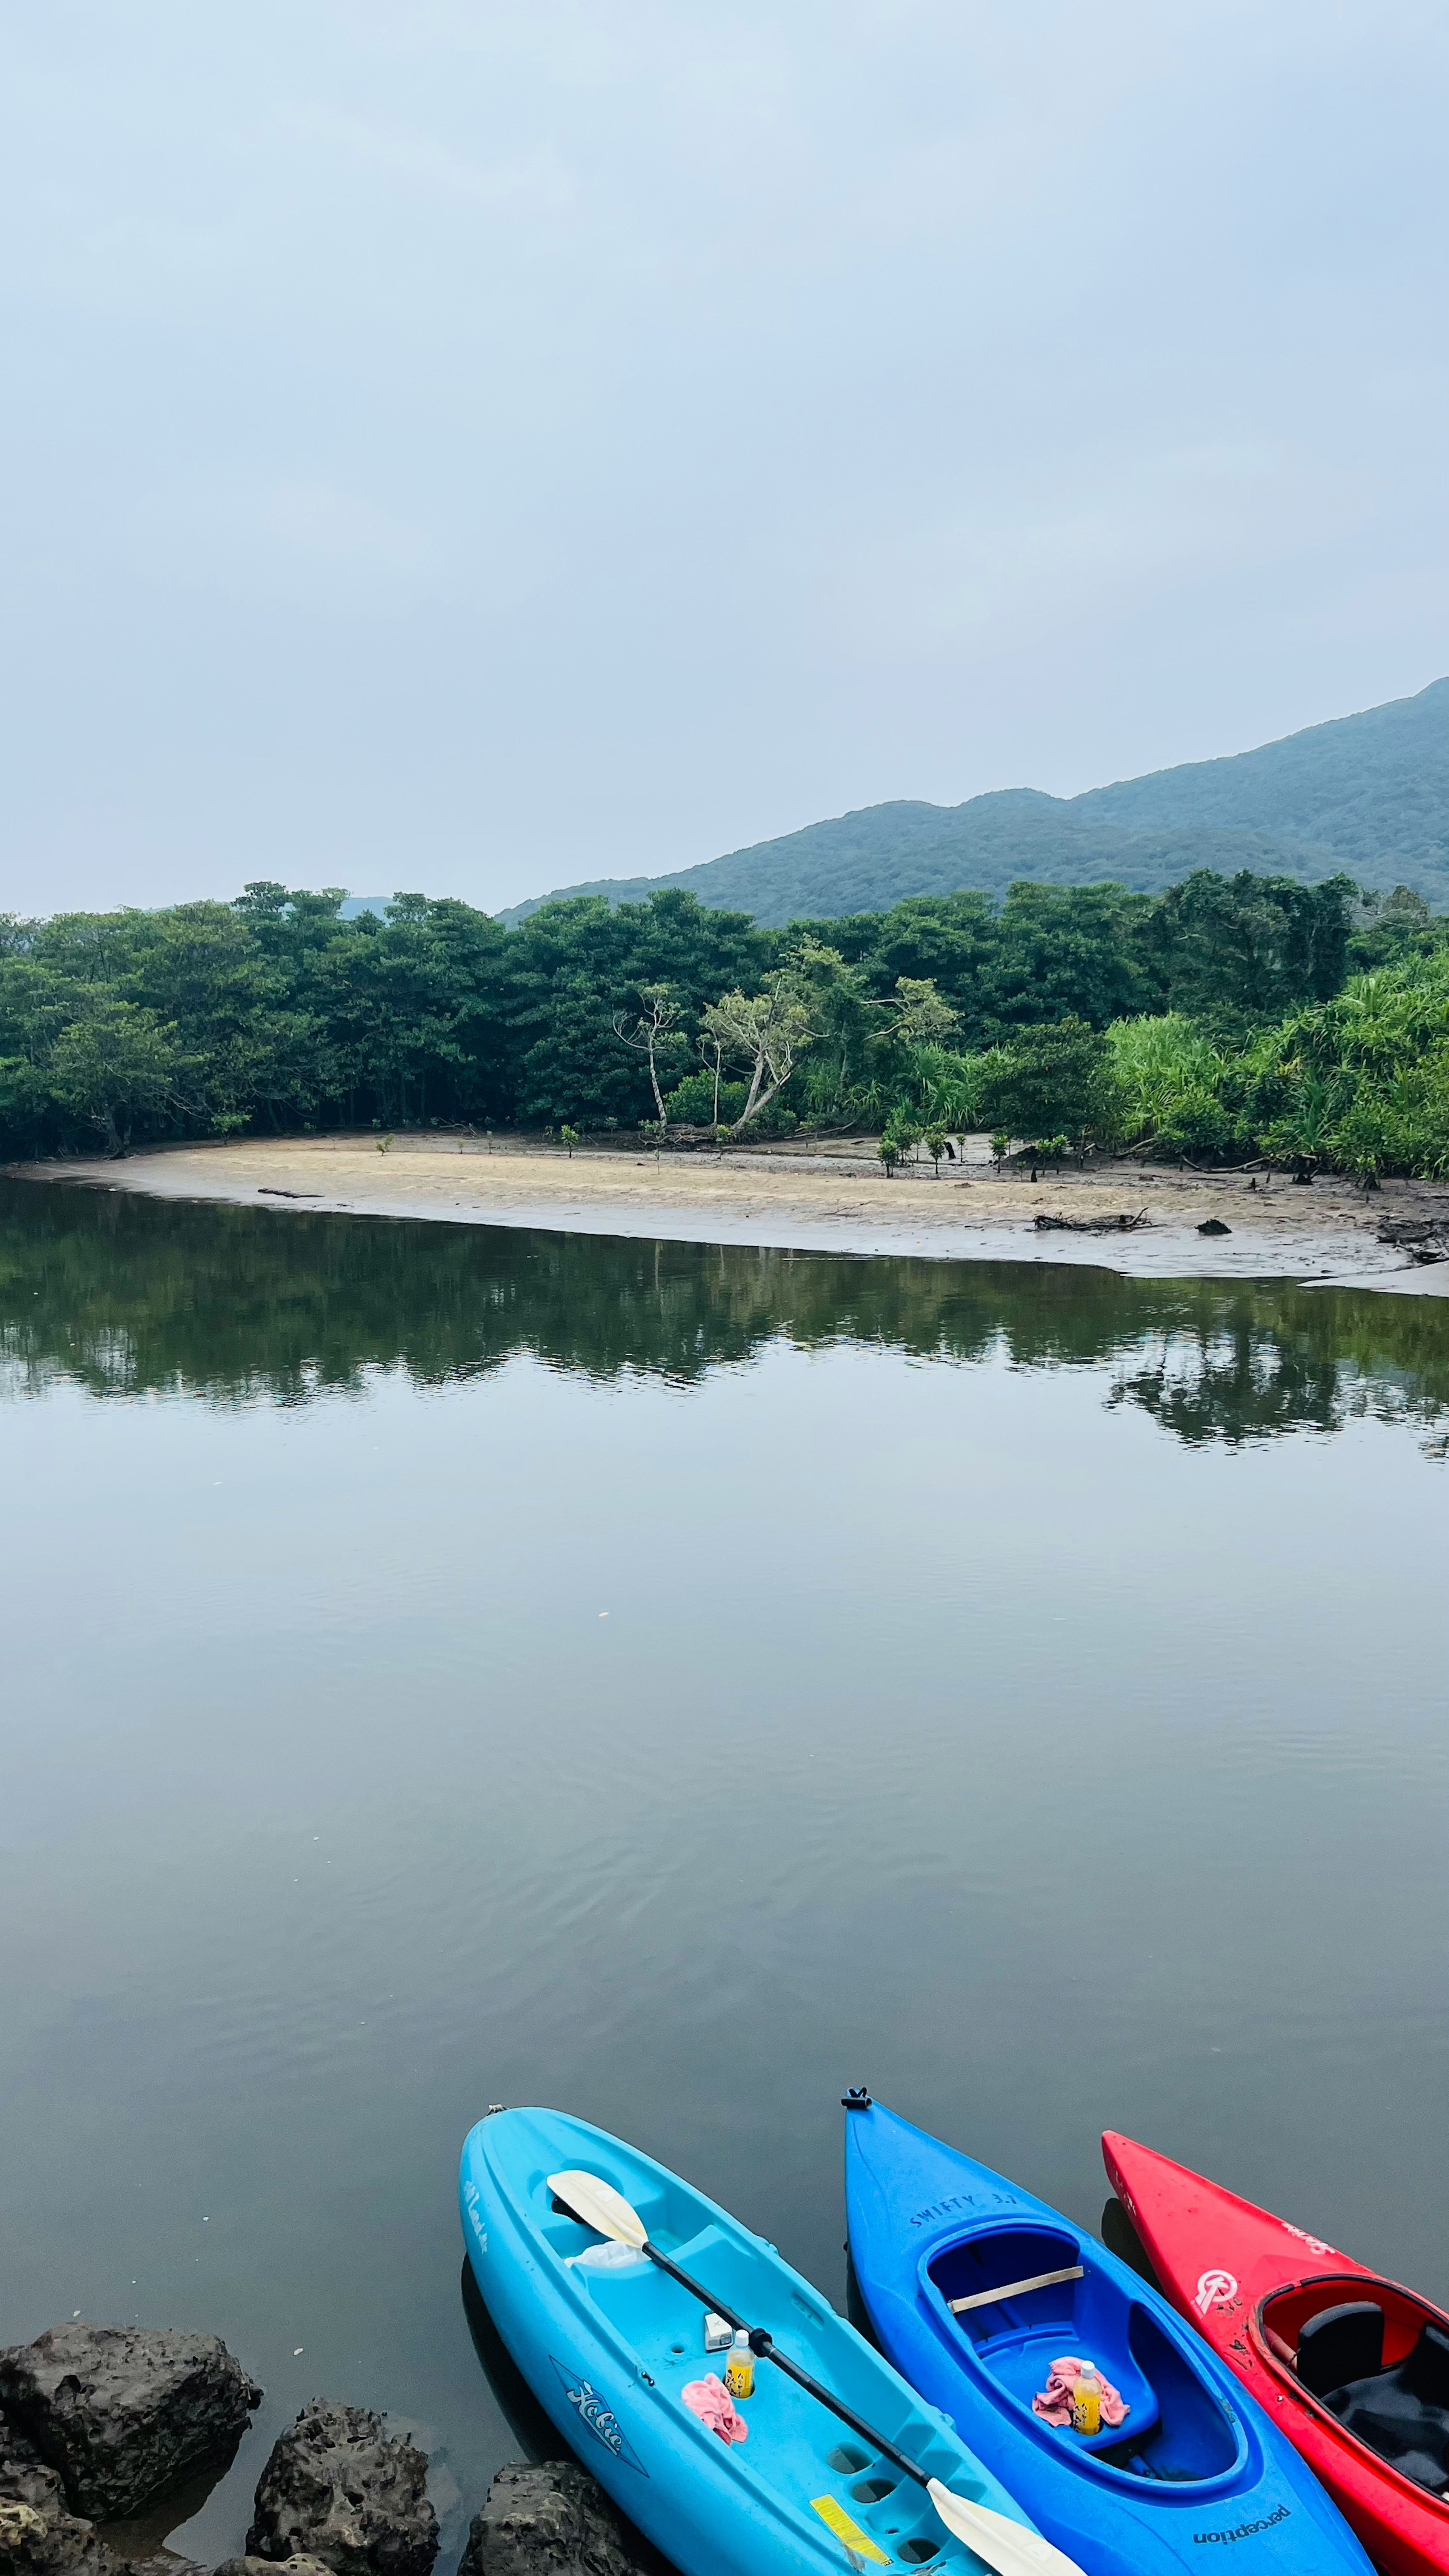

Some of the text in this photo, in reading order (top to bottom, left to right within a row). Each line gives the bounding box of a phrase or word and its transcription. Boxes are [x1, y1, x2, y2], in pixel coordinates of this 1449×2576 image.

[909, 2195, 975, 2228] SWIFTY
[566, 2379, 622, 2456] Hobie
[1193, 2504, 1291, 2545] perception
